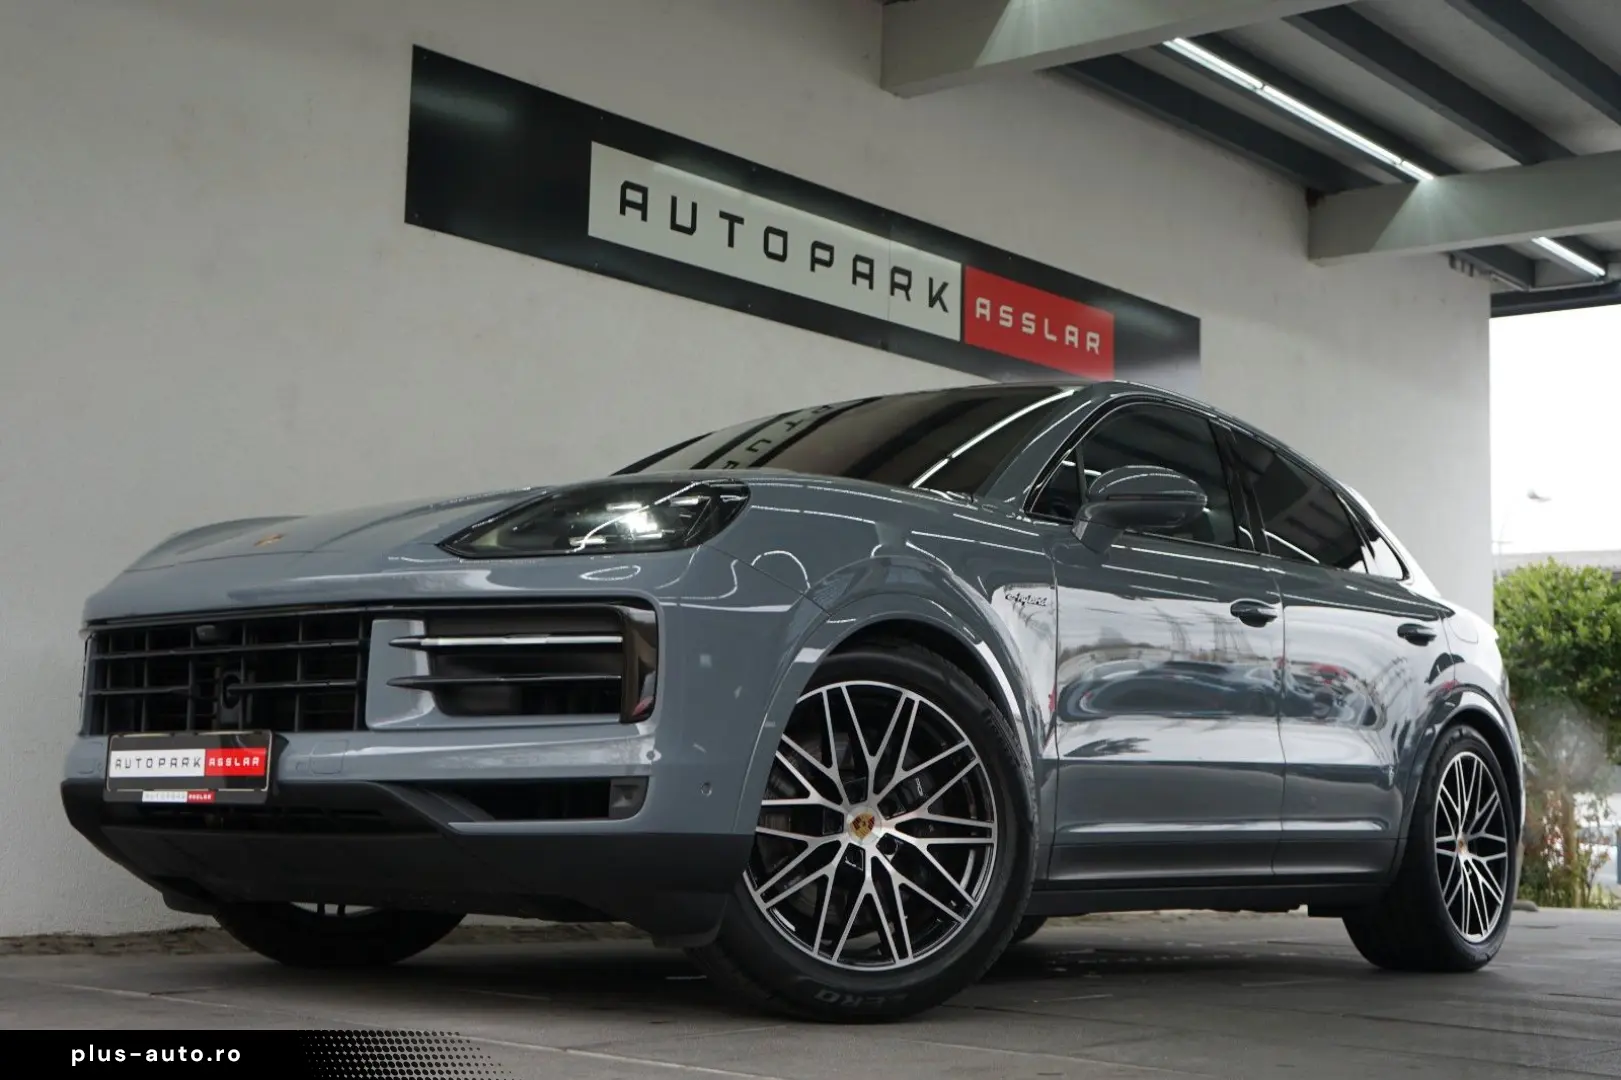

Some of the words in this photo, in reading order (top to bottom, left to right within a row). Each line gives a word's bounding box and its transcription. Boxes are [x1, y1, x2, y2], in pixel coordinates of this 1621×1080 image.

[619, 180, 949, 313] AUTOPARK
[976, 297, 1101, 354] ASSLAR
[115, 757, 202, 769] AUTOPARK
[208, 756, 260, 767] ASSLAR
